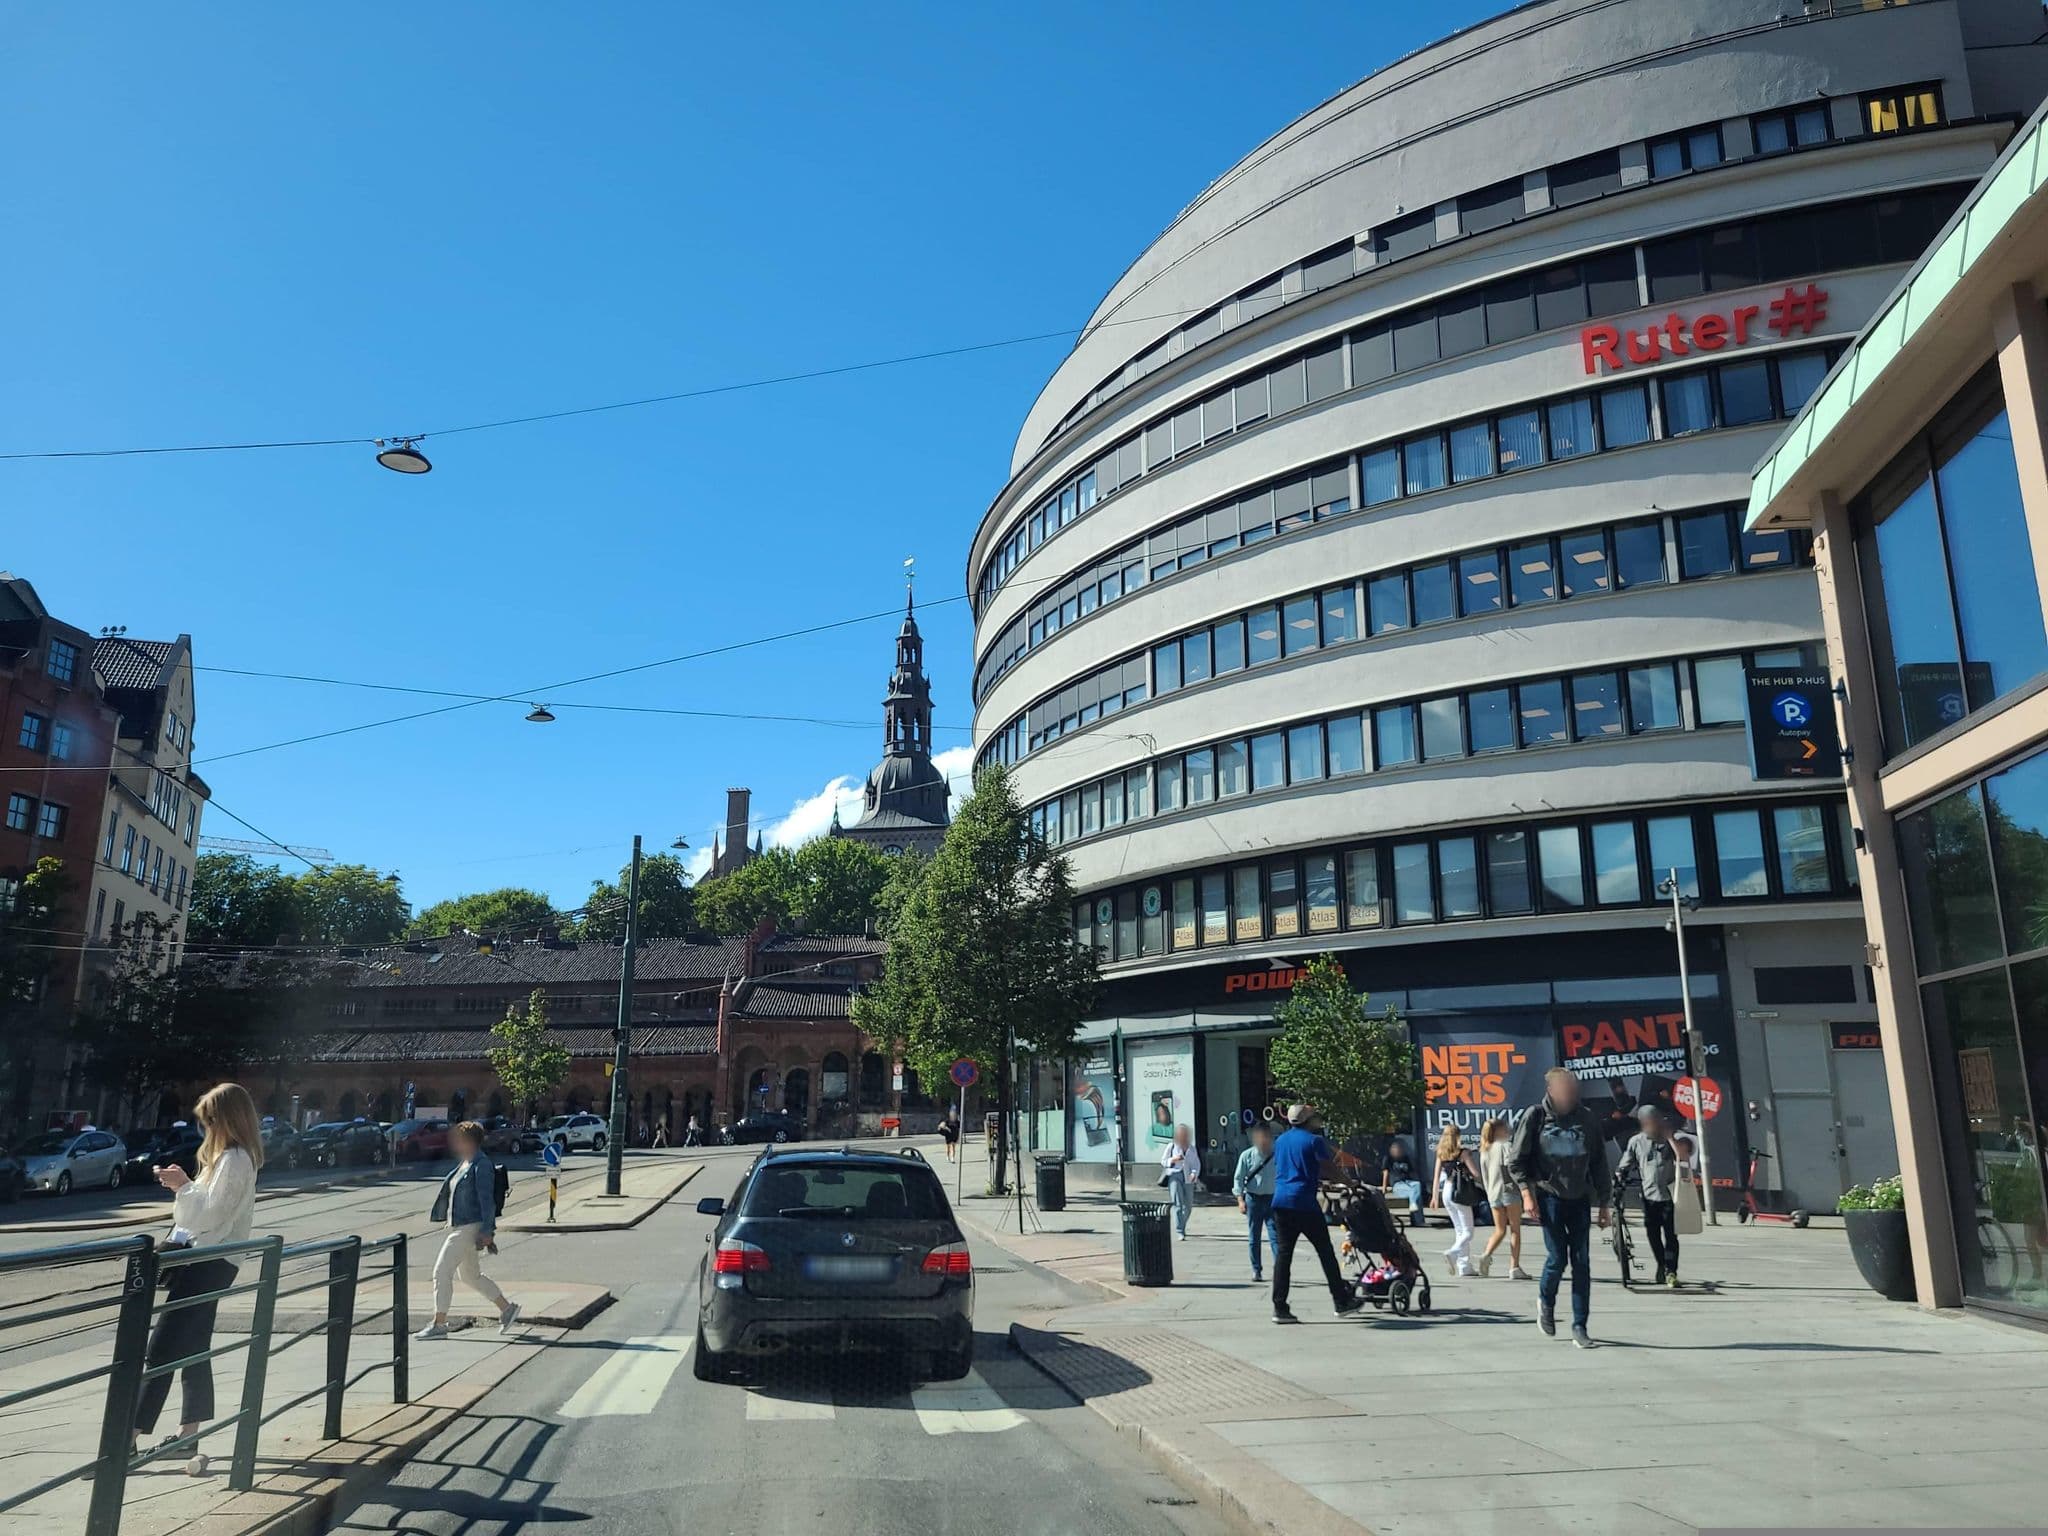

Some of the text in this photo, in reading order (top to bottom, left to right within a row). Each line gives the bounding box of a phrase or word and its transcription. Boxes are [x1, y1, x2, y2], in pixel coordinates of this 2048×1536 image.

[1752, 676, 1826, 686] THE HUB P-HUS
[1784, 703, 1801, 722] P
[1778, 729, 1811, 737] Autopay
[1238, 920, 1260, 931] Atlas
[1276, 914, 1296, 927] Atlas
[1311, 910, 1336, 922] Atlas
[1176, 929, 1194, 940] Atlas
[1562, 1012, 1684, 1057] PANT
[1839, 1034, 1883, 1047] PO
[1422, 1043, 1527, 1075] NETT-
[1564, 1055, 1606, 1070] BRUKT
[1702, 1044, 1720, 1056] OG
[1573, 1063, 1645, 1080] VITEVARER
[1646, 1060, 1675, 1074] HOS
[1424, 1074, 1506, 1105] PRIS
[1675, 1093, 1718, 1112] NOGE
[1426, 1109, 1432, 1129] I
